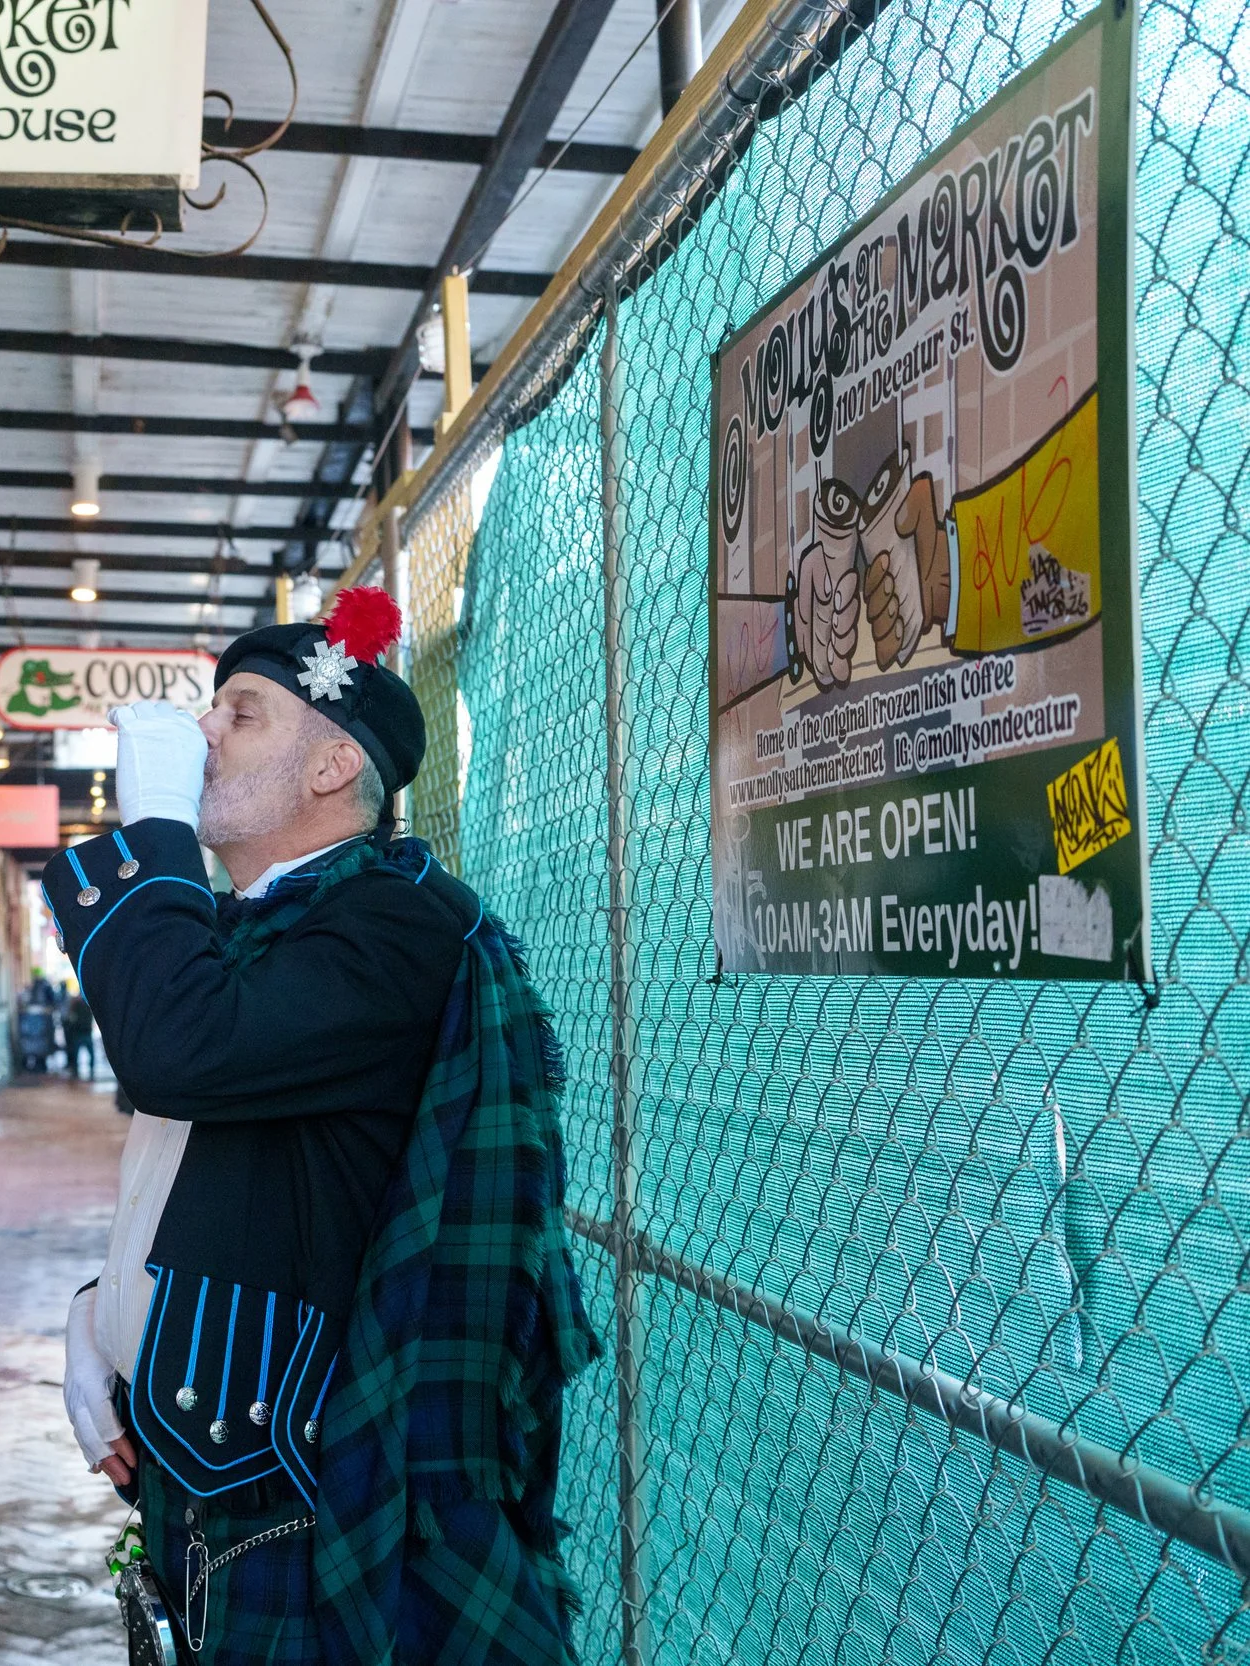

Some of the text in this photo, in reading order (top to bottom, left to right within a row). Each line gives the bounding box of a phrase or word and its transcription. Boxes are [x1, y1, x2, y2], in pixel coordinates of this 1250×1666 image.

[836, 304, 975, 432] 1107 Decatur St.
[85, 660, 203, 701] COOP'S
[757, 659, 1015, 759] Home of the original Frozen Irish Coffee
[730, 699, 1078, 804] www.mollysatthemarket.net IG: @mollysondecatur
[776, 787, 977, 872] WE ARE OPEN!
[755, 884, 1039, 969] 10AM-3AM Everyday!
